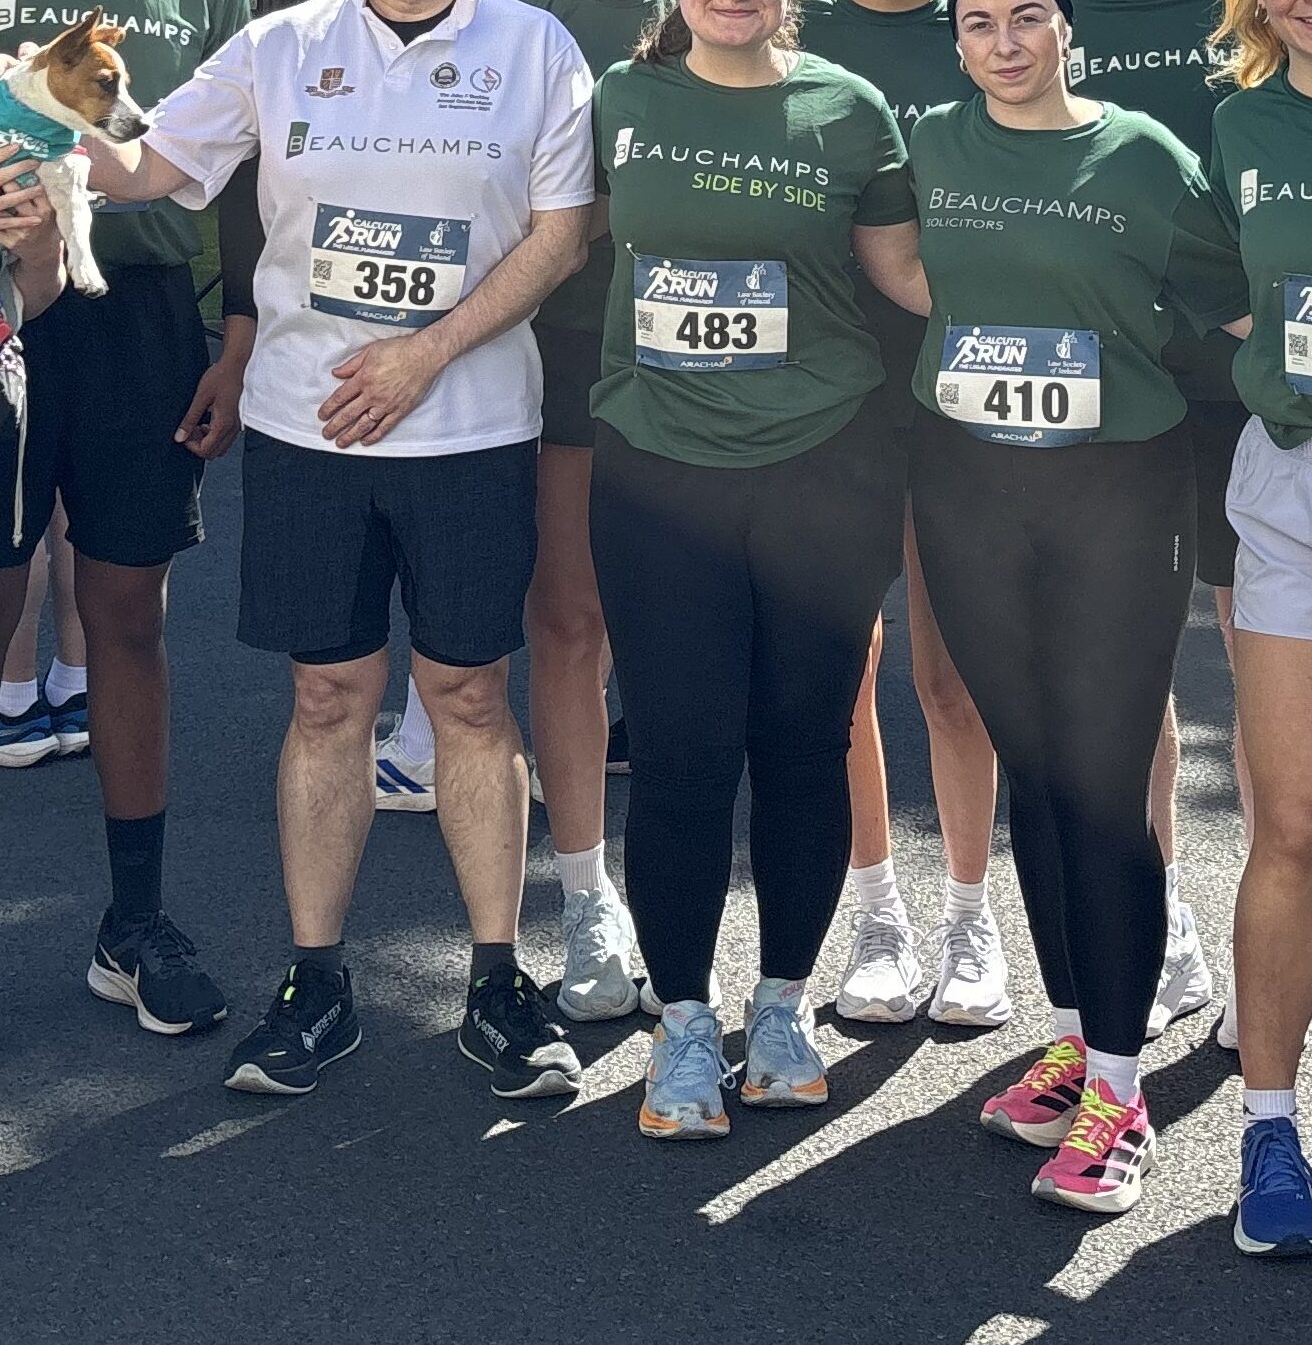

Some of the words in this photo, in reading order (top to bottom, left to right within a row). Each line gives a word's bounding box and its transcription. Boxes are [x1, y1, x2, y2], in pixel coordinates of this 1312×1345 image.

[1070, 48, 1242, 80] BEAUCHAMP
[288, 135, 502, 159] BEAUCHAMPS
[616, 142, 829, 186] BEAUCHAMPS
[692, 172, 743, 195] SIDE
[749, 179, 778, 199] BY
[783, 185, 826, 212] SIDE
[928, 187, 1127, 234] BEAUCHAMPS
[354, 219, 402, 232] CALCUTTA
[925, 217, 1005, 231] SOLICITORS
[350, 227, 403, 249] RUN
[354, 260, 436, 305] 358
[671, 268, 718, 280] CALCUTTA
[669, 276, 718, 298] RUN
[676, 312, 758, 350] 483
[979, 336, 1027, 346] CALCUTTA
[976, 345, 1027, 365] RUN
[984, 380, 1069, 424] 410
